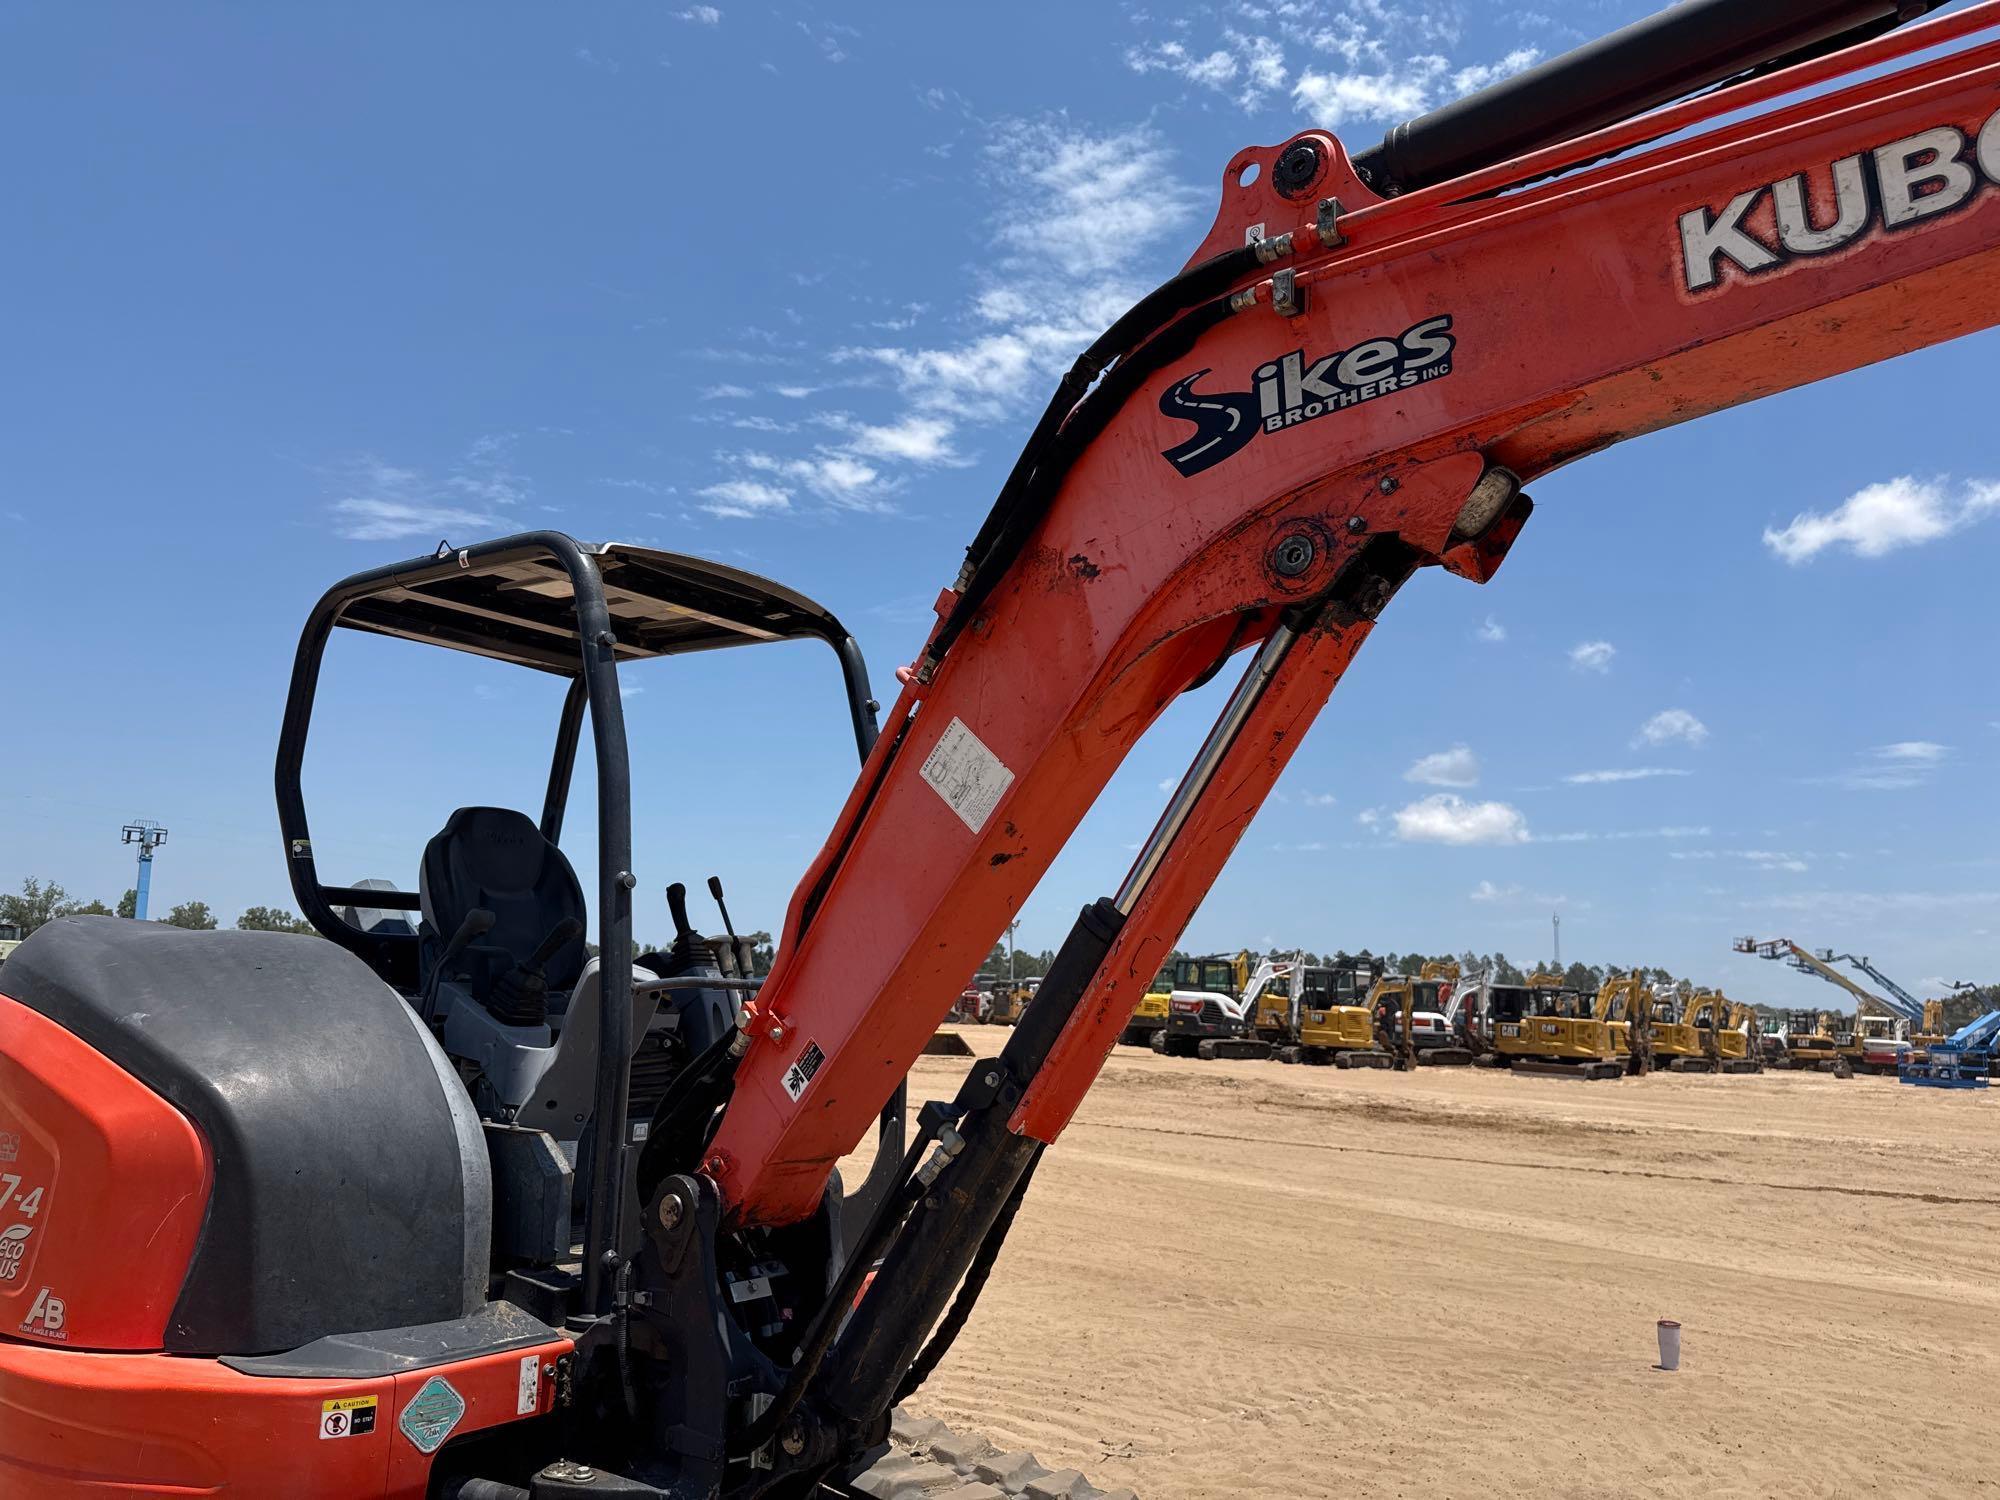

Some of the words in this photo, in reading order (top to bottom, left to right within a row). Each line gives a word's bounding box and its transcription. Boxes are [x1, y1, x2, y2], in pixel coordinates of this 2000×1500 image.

[1679, 104, 2000, 290] KUB
[1159, 315, 1454, 478] Sikes
[1266, 369, 1419, 432] BROTHERS
[1422, 363, 1450, 381] INC
[1501, 1025, 1518, 1037] CAT
[1541, 1024, 1556, 1033] CAT
[1797, 1038, 1810, 1047] CAT
[24, 1288, 64, 1330] AB
[342, 1400, 370, 1408] CAUTION
